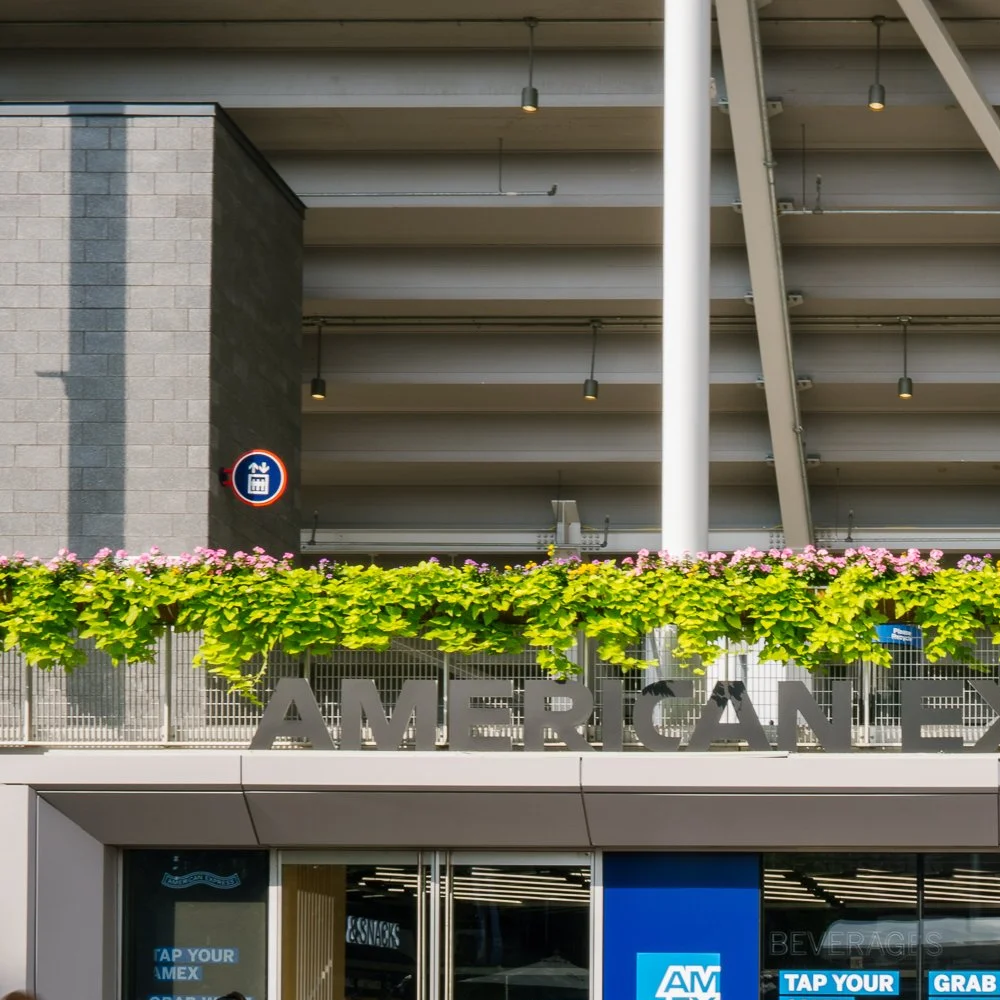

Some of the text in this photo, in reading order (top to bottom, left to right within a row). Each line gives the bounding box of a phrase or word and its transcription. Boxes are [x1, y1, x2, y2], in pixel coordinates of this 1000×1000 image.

[250, 678, 851, 751] AMERICAN
[769, 931, 943, 957] BEVERAGES
[187, 948, 235, 963] YOUR
[784, 973, 894, 993] TAP YOUR
[933, 974, 997, 993] GRAB
